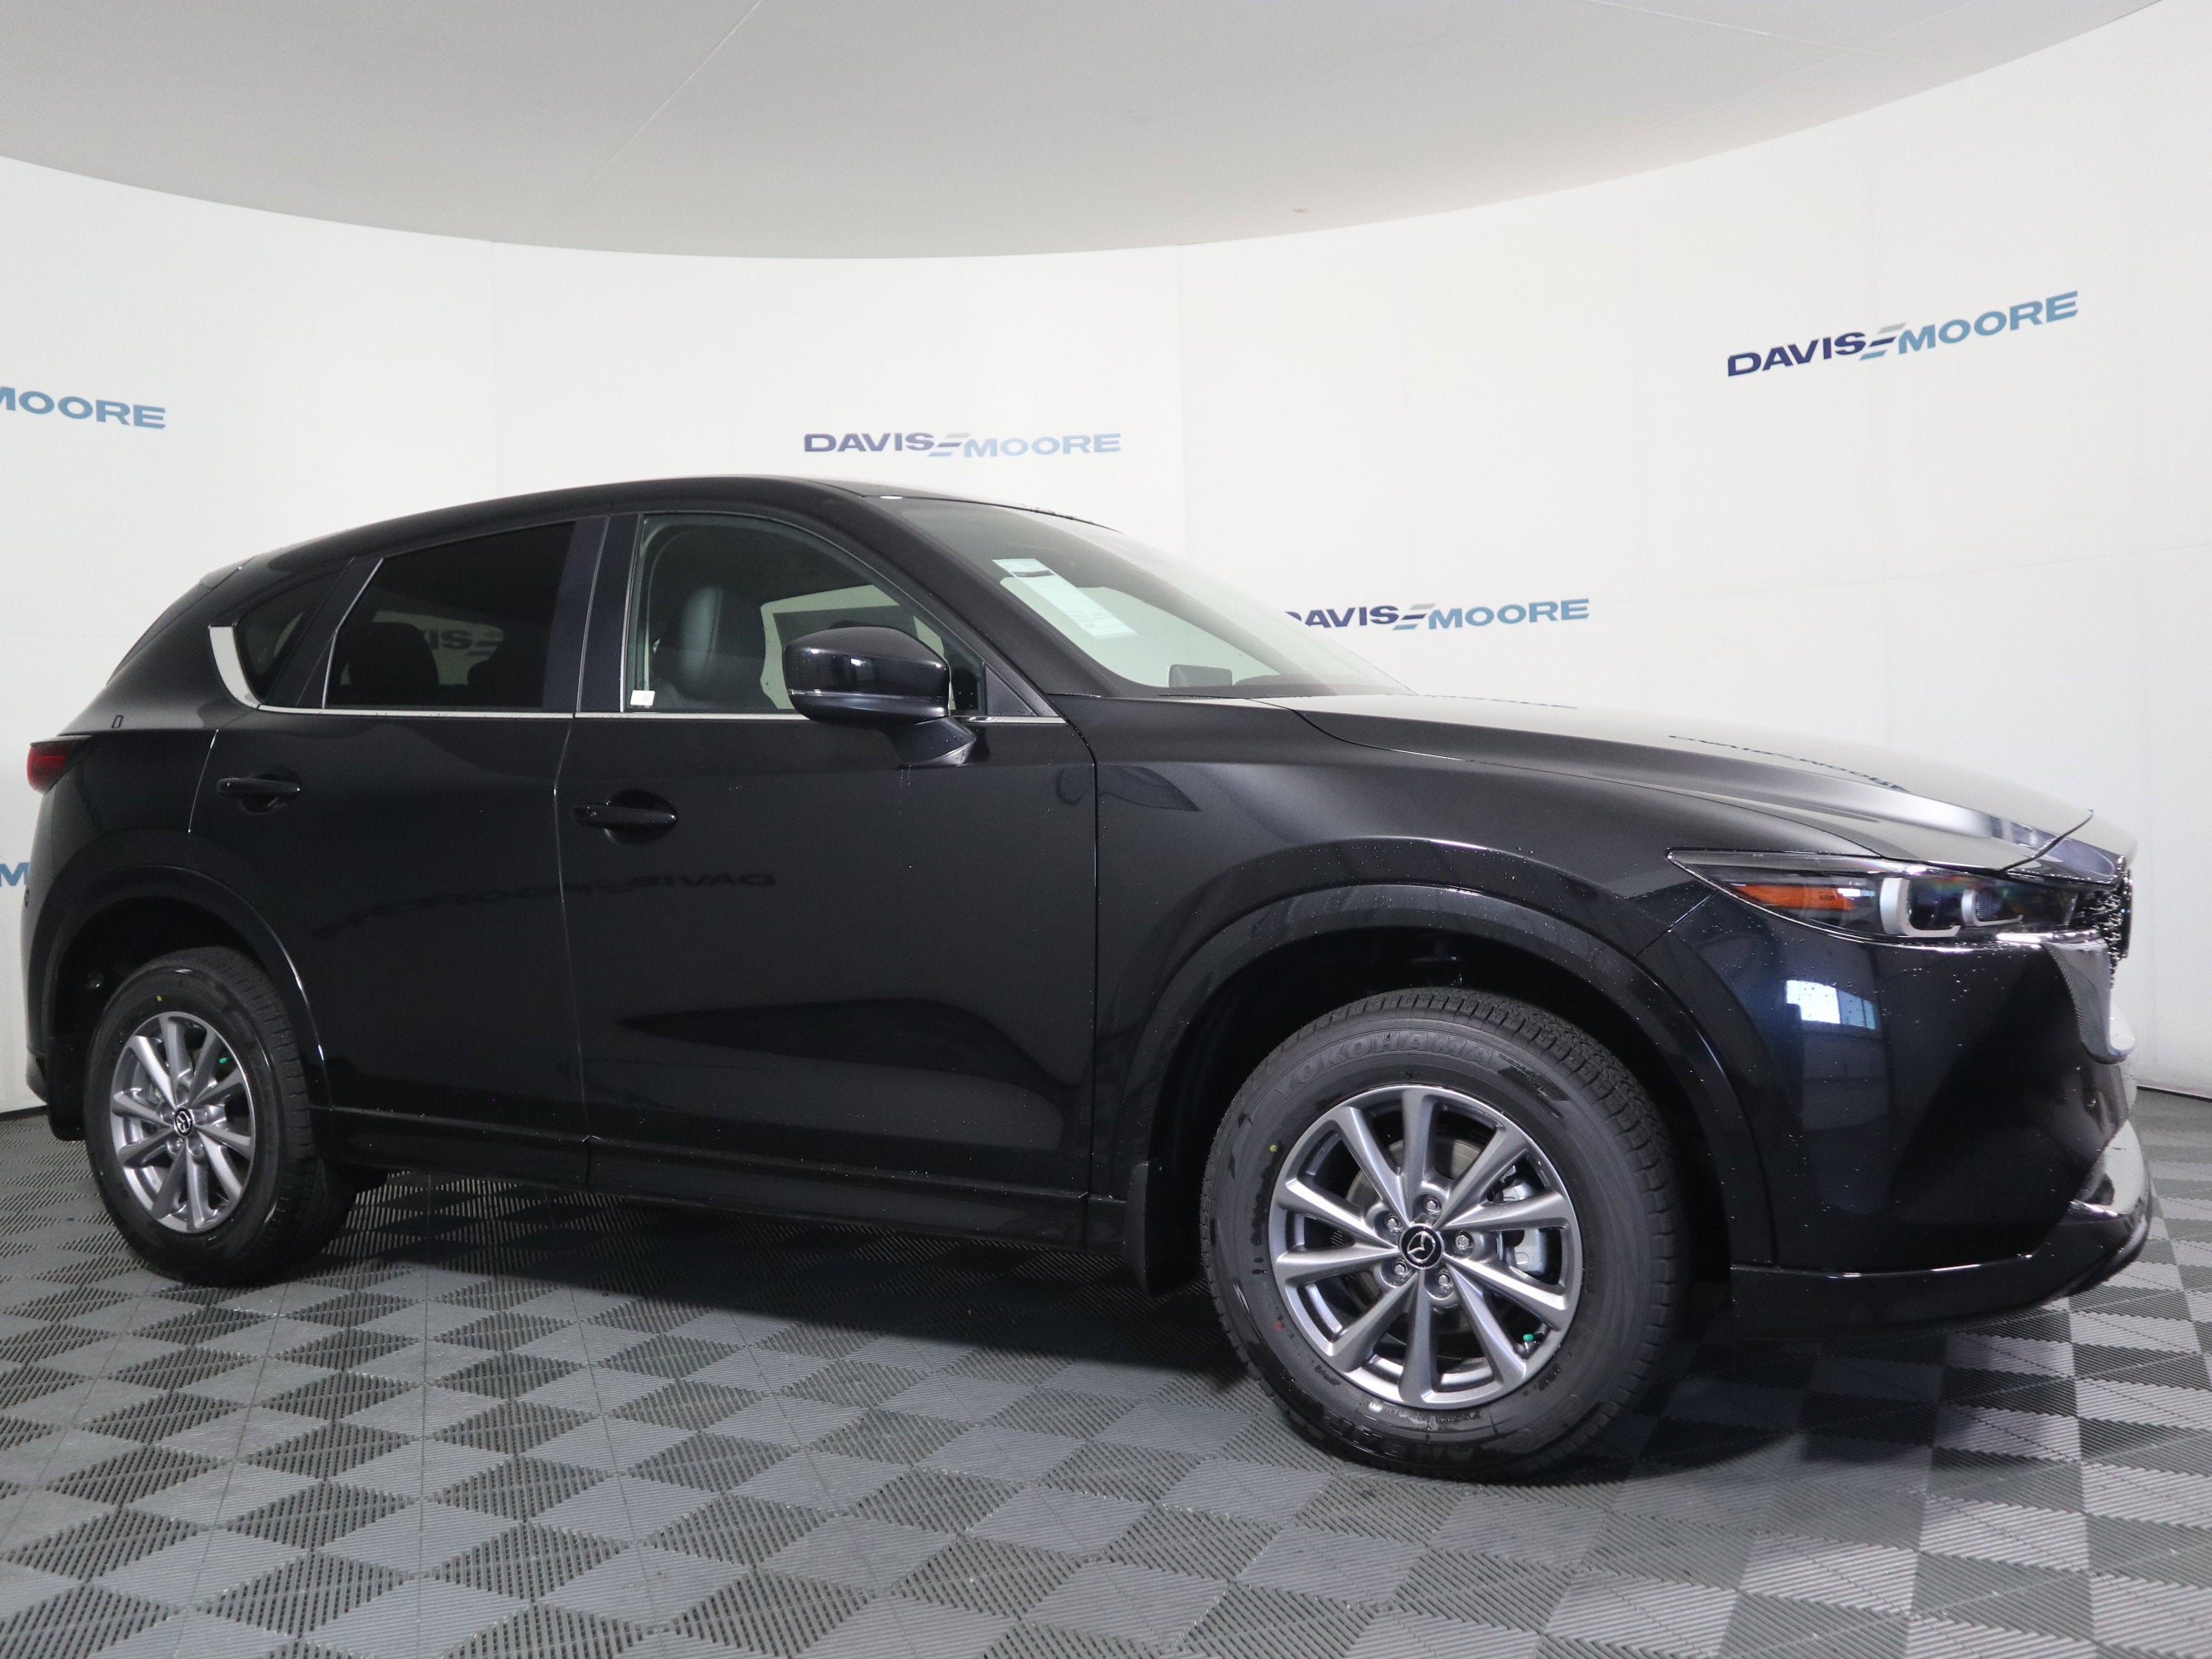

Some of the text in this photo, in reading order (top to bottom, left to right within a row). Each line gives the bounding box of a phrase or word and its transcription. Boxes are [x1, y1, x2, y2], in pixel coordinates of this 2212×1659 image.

[1727, 291, 2079, 377] DAVIS MOORE
[804, 432, 1122, 458] DAVIS MOORE
[1427, 597, 1590, 630] MOORE
[1273, 1031, 1496, 1100] YOKOHAMA
